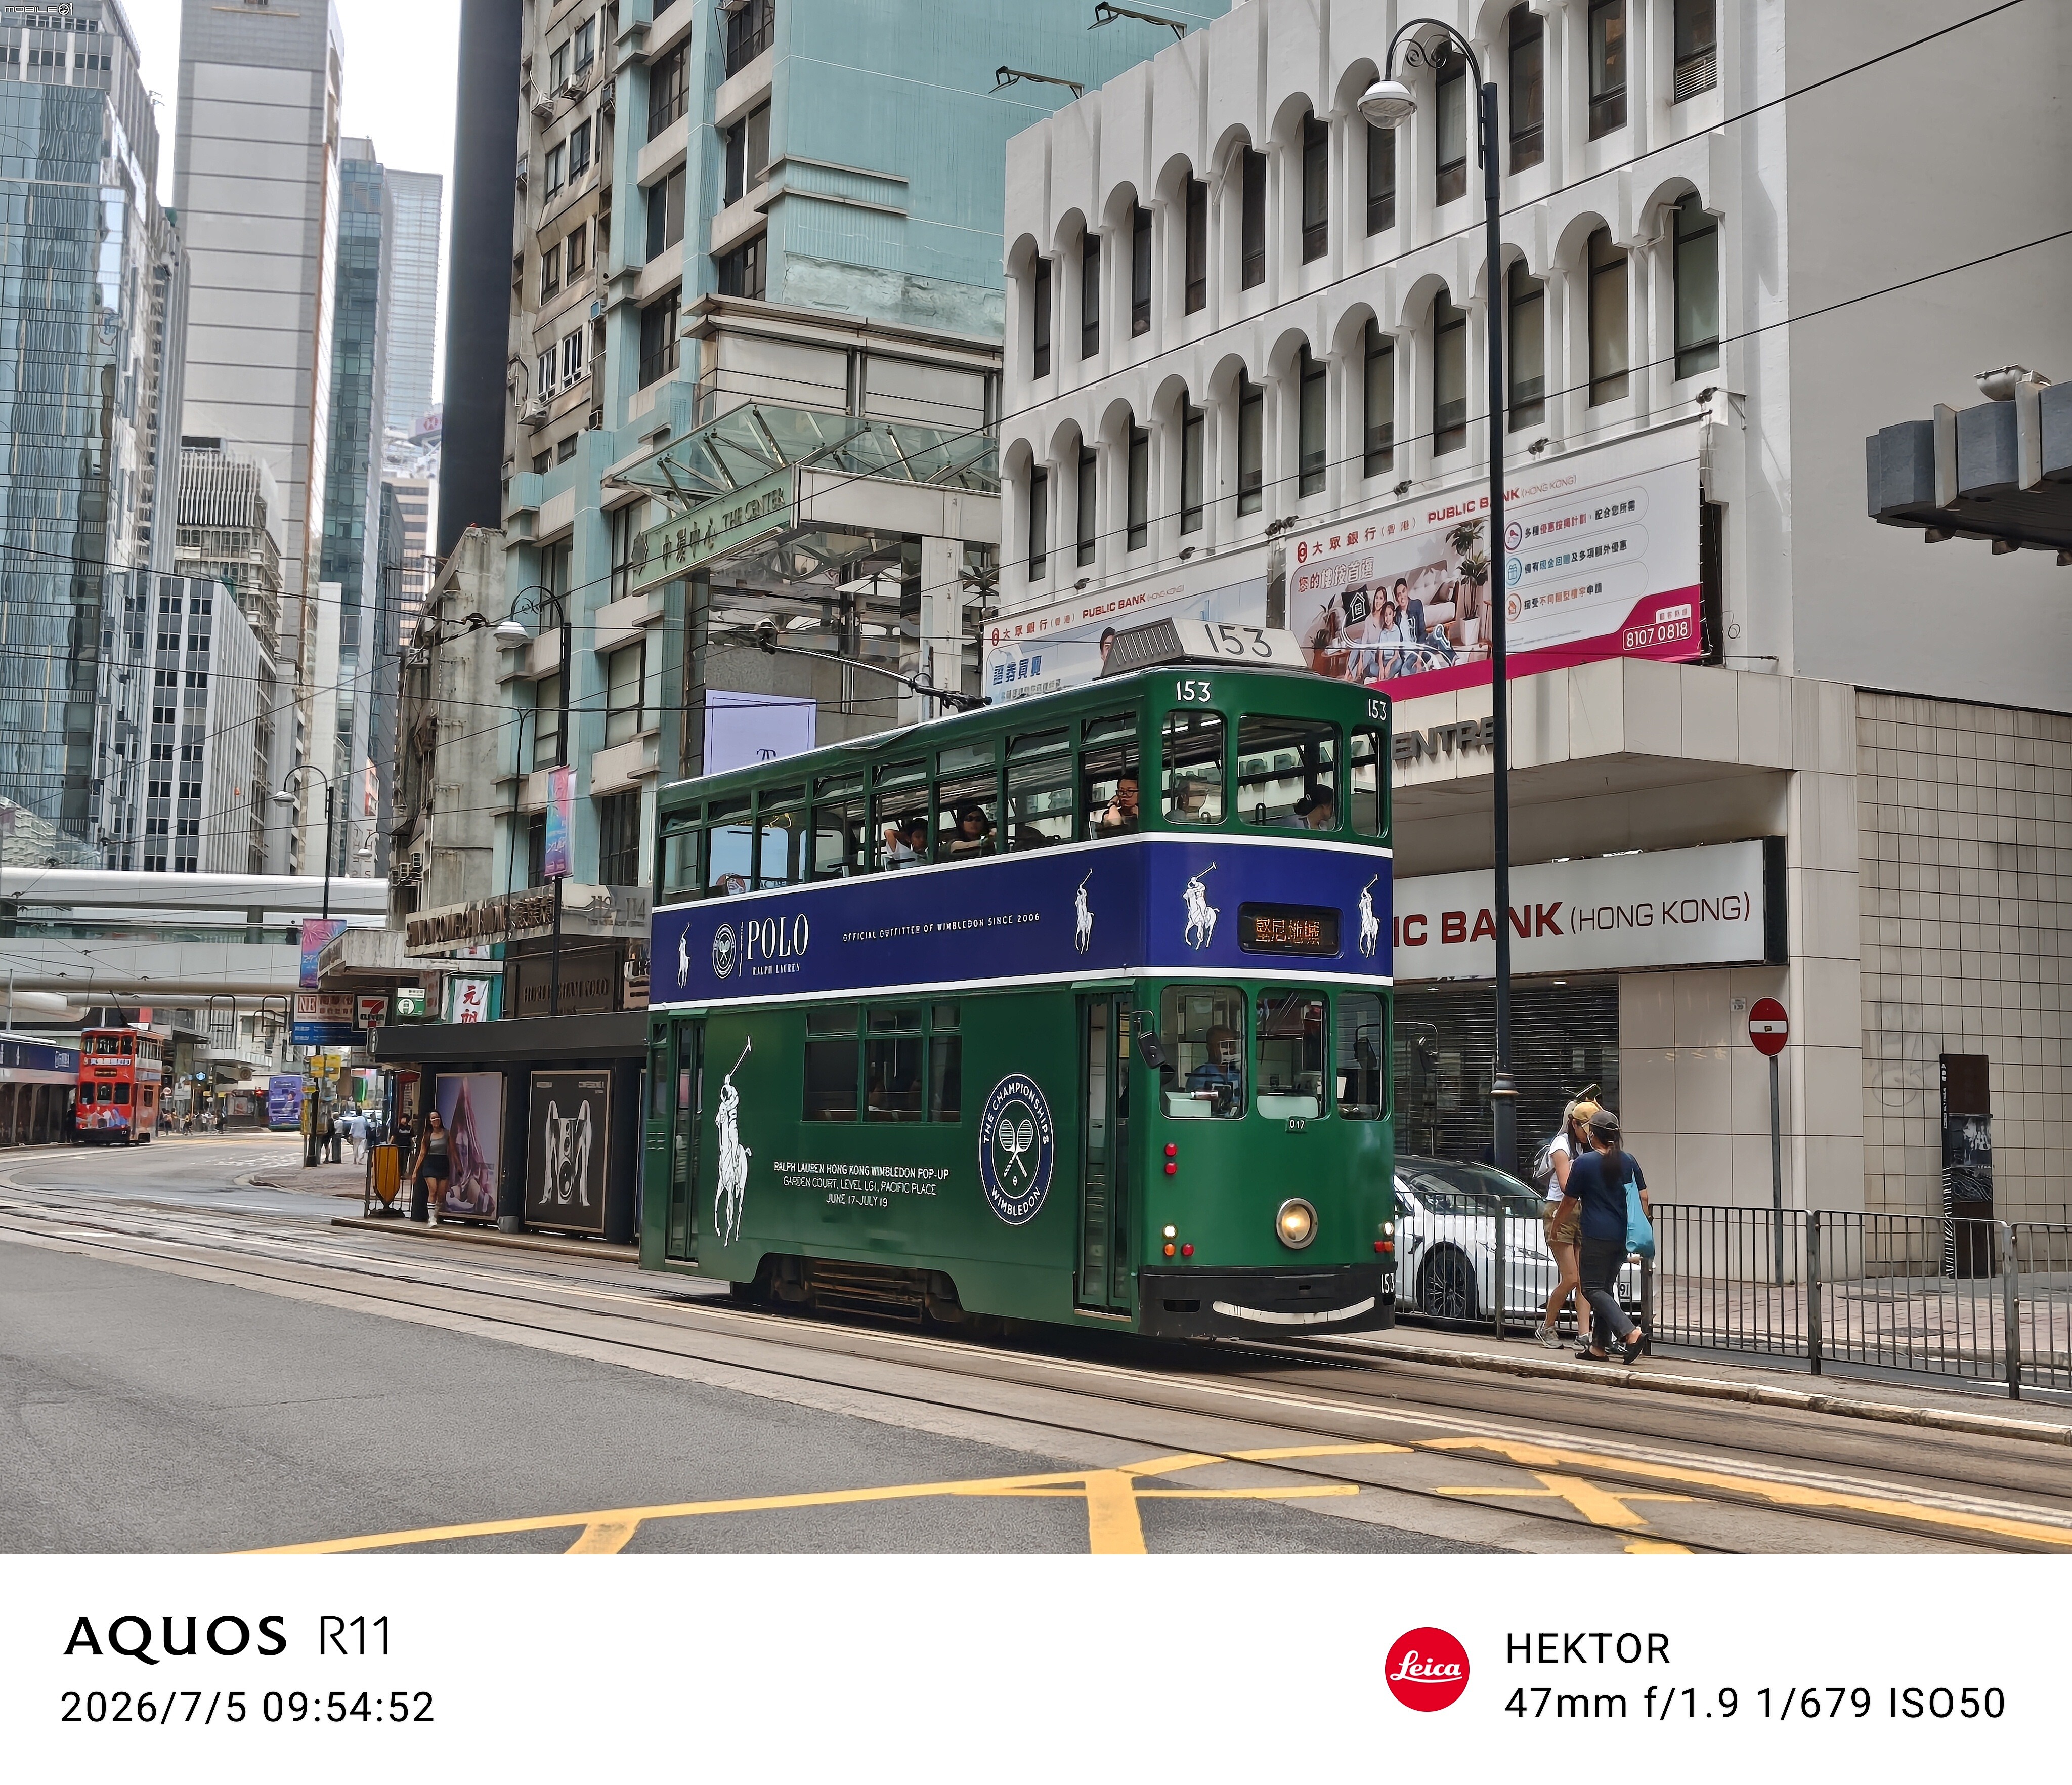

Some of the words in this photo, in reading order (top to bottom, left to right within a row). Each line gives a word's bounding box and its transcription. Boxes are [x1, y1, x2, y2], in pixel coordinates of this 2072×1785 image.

[722, 507, 743, 529] THE
[745, 487, 786, 521] CENTER
[1428, 501, 1476, 523] PUBLIC
[1480, 487, 1520, 509] BNK
[1522, 484, 1548, 498] (HONG
[1550, 474, 1577, 488] KONG)
[1083, 602, 1116, 618] PUBLIC
[1118, 592, 1147, 609] BANK
[1204, 623, 1272, 658] 153
[1626, 628, 1654, 647] 8107
[1658, 621, 1688, 641] 0818
[1176, 681, 1212, 703] 153
[1368, 698, 1387, 721] 153
[1392, 716, 1494, 760] ENTRE
[843, 931, 876, 942] OFFICIAL
[879, 925, 920, 938] OUTFITTER
[923, 924, 933, 932] OF
[937, 919, 984, 931] WIMBLEDON
[987, 915, 1013, 926] SINCE
[1017, 913, 1040, 923] 2006
[1442, 902, 1564, 944] BANK
[1571, 903, 1654, 935] (HONG
[1662, 891, 1750, 924] KONG)
[747, 914, 809, 960] POLO
[753, 965, 772, 976] RALPH
[983, 1112, 995, 1143] THE
[992, 1082, 1049, 1144] CHAMPIONSHIPS
[774, 1162, 796, 1172] RALPH
[797, 1163, 825, 1173] LAUREN
[826, 1164, 848, 1175] HONG
[849, 1165, 870, 1176] KONG
[871, 1166, 916, 1178] WIMBLEDON
[918, 1168, 949, 1180] POP-UP
[783, 1176, 810, 1187] GARDEN
[841, 1179, 862, 1191] LEVEL
[881, 1181, 910, 1194] PACIFIC
[912, 1183, 936, 1196] PLACE
[826, 1193, 846, 1204] JUNE
[880, 1197, 888, 1207] 19
[991, 1184, 1041, 1216] WIMBLEDON
[1381, 1274, 1395, 1294] 153
